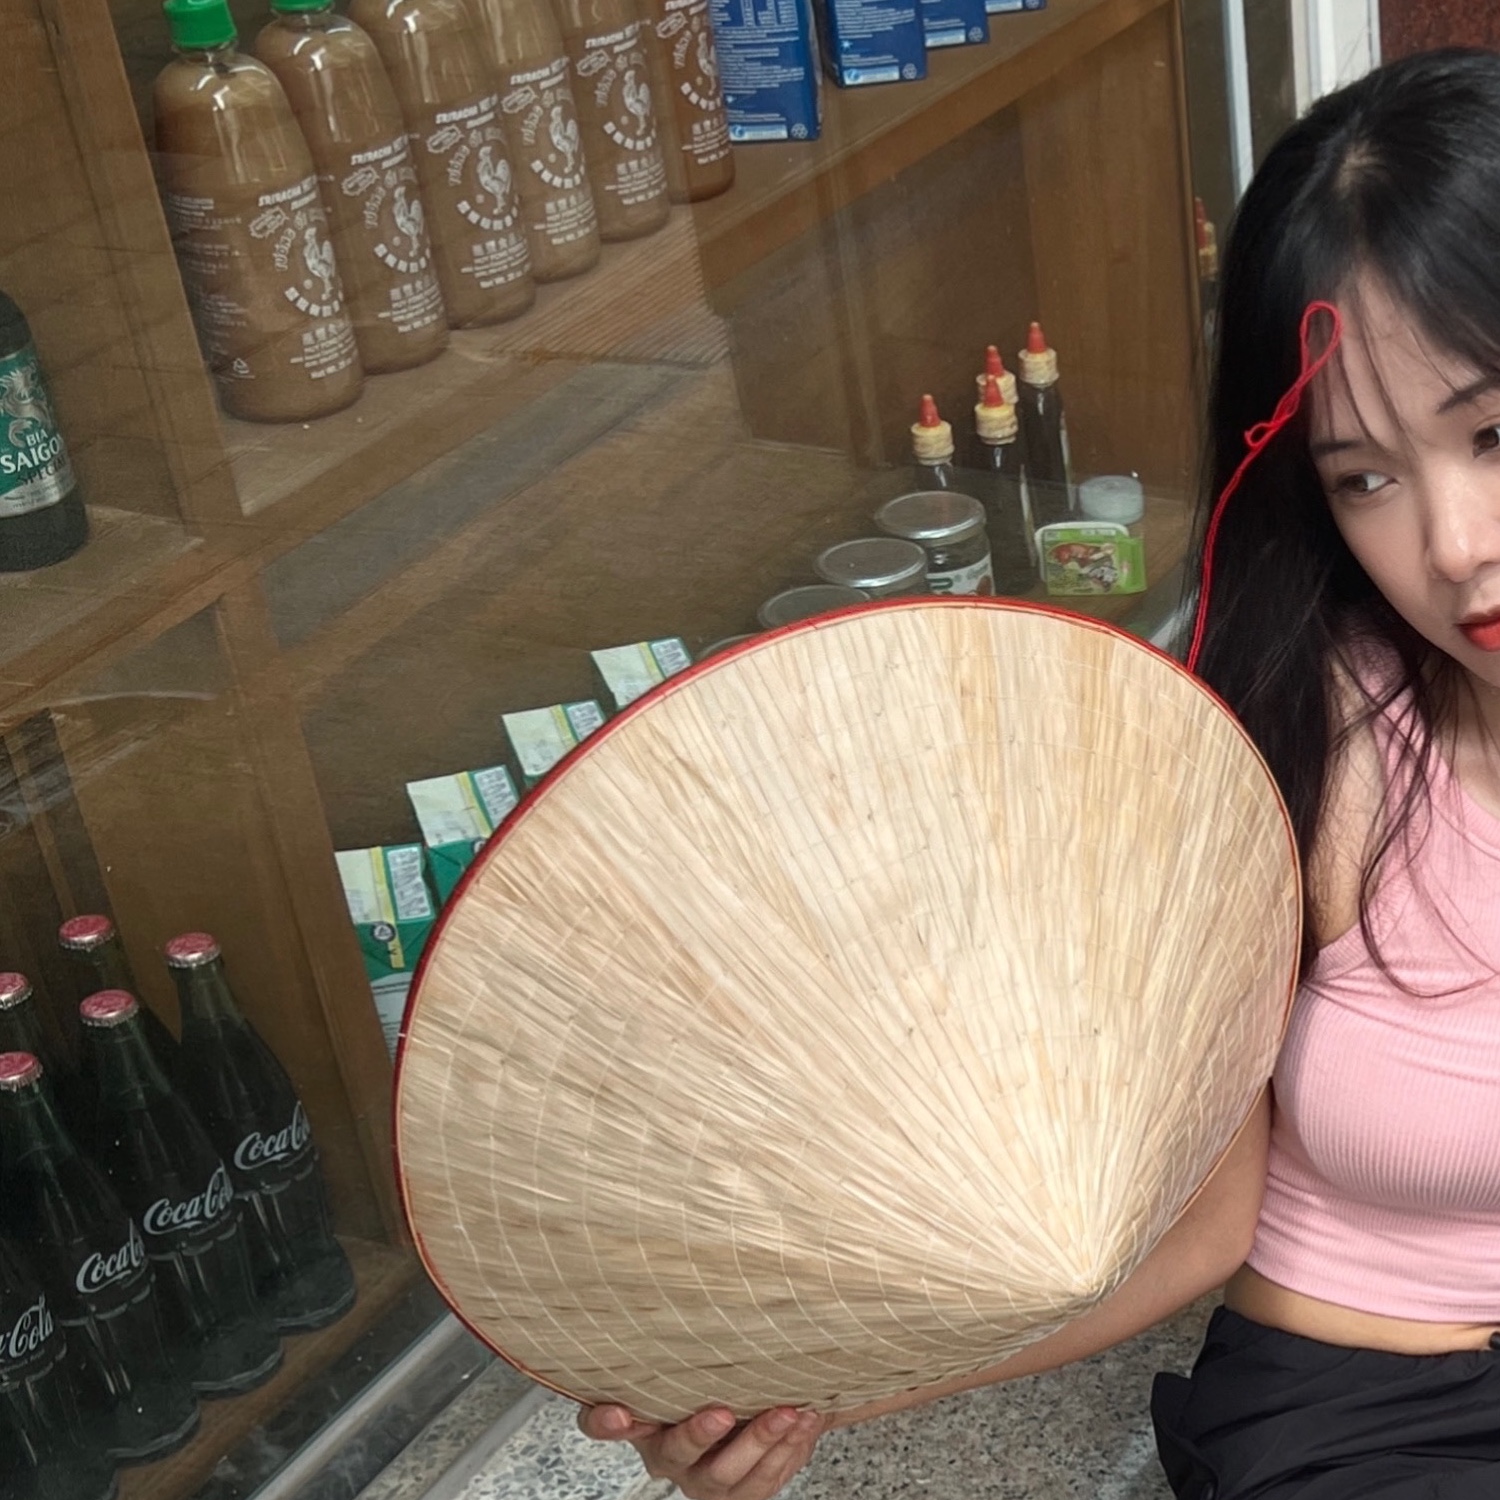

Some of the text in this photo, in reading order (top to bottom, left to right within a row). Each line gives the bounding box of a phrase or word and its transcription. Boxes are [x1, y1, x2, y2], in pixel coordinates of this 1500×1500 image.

[26, 428, 48, 447] BIA
[234, 1101, 311, 1170] Coca-Co
[143, 1158, 234, 1234] Coca-Col
[76, 1217, 146, 1293] Coca-C
